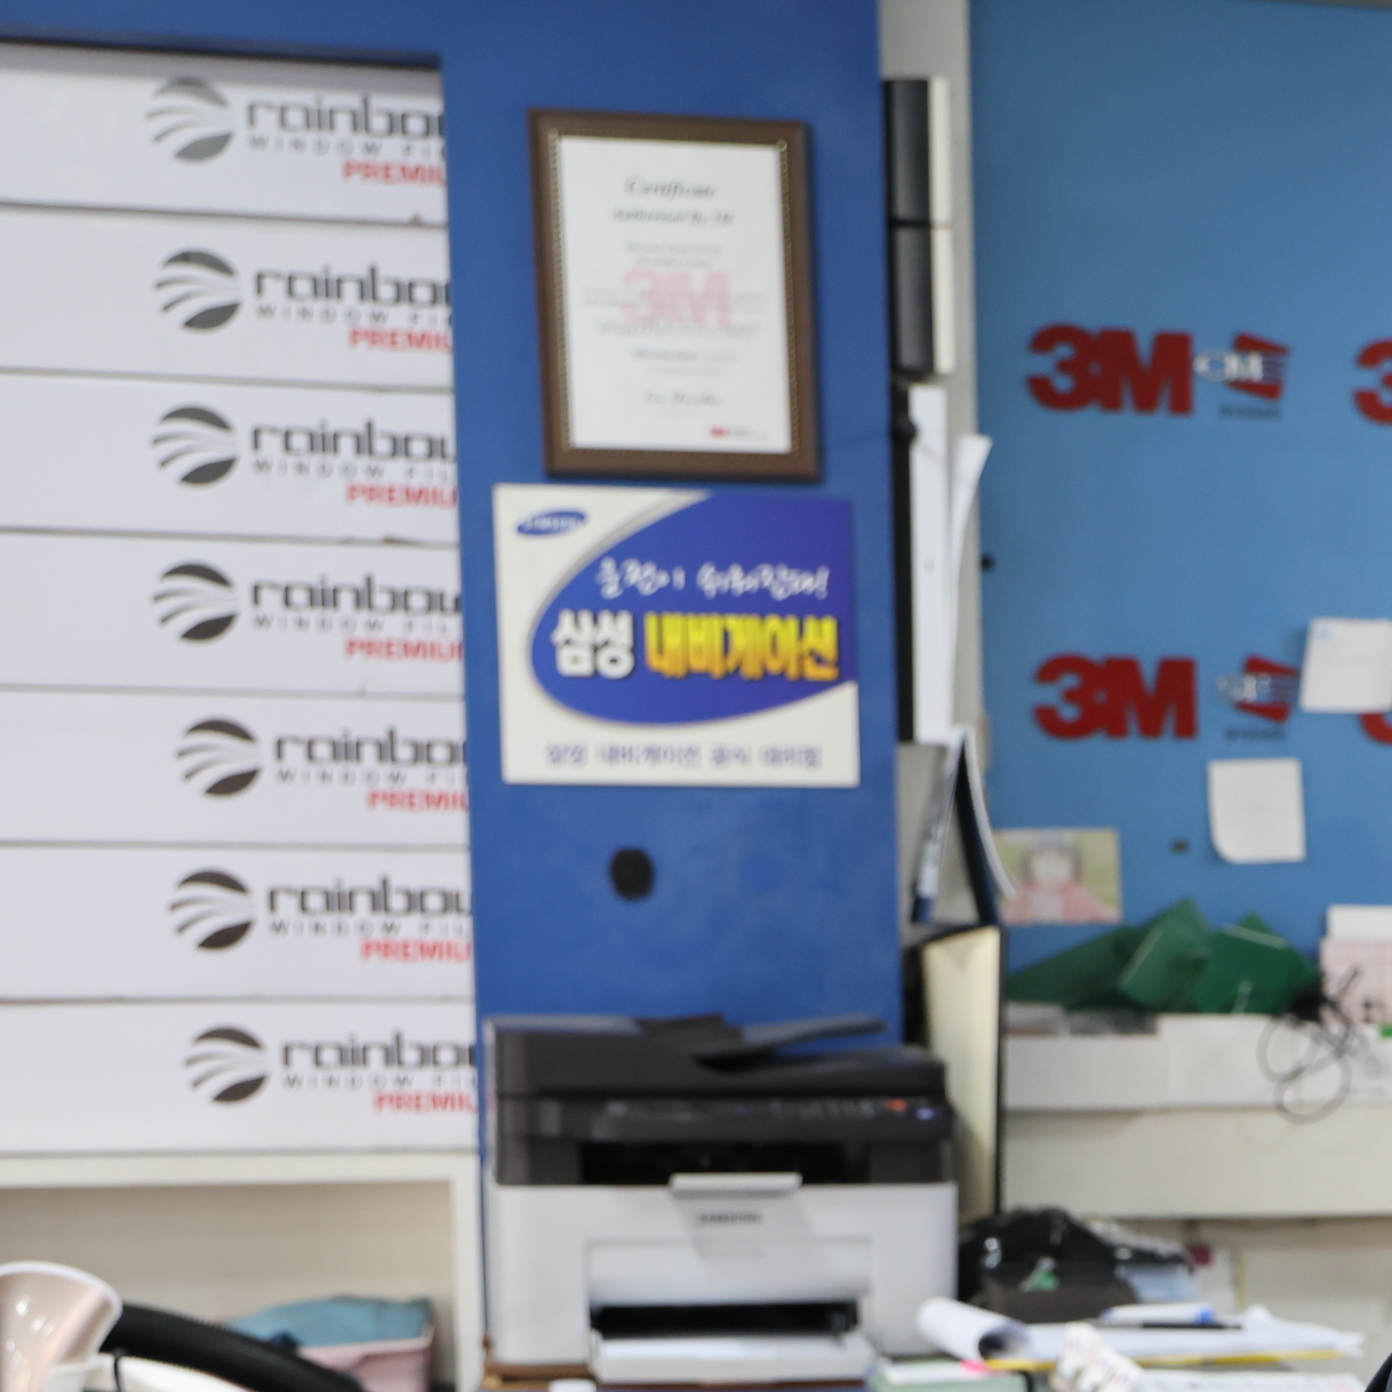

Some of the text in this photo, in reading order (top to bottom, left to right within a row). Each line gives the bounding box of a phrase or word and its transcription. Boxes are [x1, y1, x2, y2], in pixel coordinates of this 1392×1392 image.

[1026, 322, 1194, 418] 3M
[551, 607, 636, 680] 삼성
[1032, 652, 1198, 741] 3M
